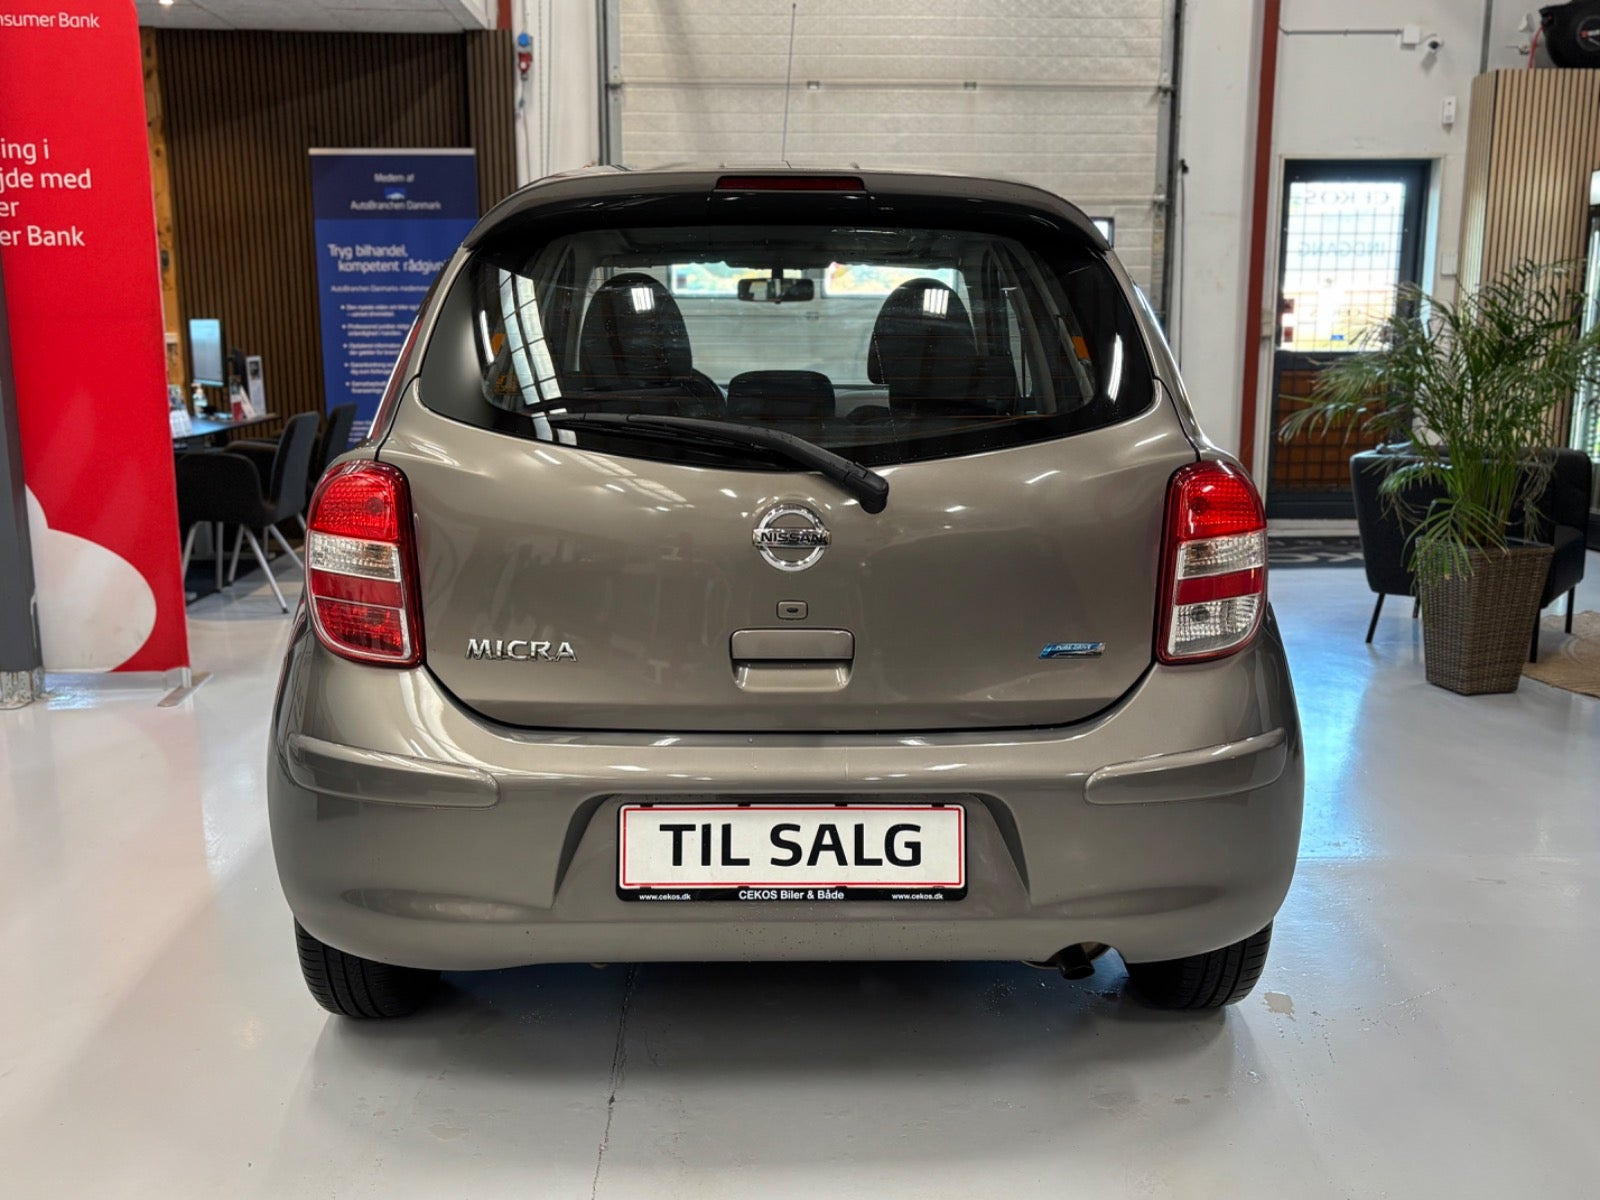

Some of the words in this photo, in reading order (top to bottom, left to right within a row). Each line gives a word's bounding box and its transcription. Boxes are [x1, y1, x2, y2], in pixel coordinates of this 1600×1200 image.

[59, 12, 100, 28] Bank
[1, 138, 37, 165] ing
[43, 138, 49, 160] i
[41, 168, 92, 189] med
[406, 200, 441, 210] Danmark
[27, 225, 85, 246] Bank
[327, 243, 353, 260] Tryg
[338, 260, 399, 274] kompetent
[760, 531, 828, 545] NISSAN
[465, 638, 577, 661] MICRA
[659, 823, 751, 867] TIL
[769, 822, 922, 867] SALG
[638, 892, 692, 900] www.cekos.dk
[738, 889, 778, 900] CEKOS
[780, 889, 804, 900] Biler
[806, 889, 815, 900] &
[817, 888, 845, 900] Både
[891, 892, 944, 900] www.cekos.dk
